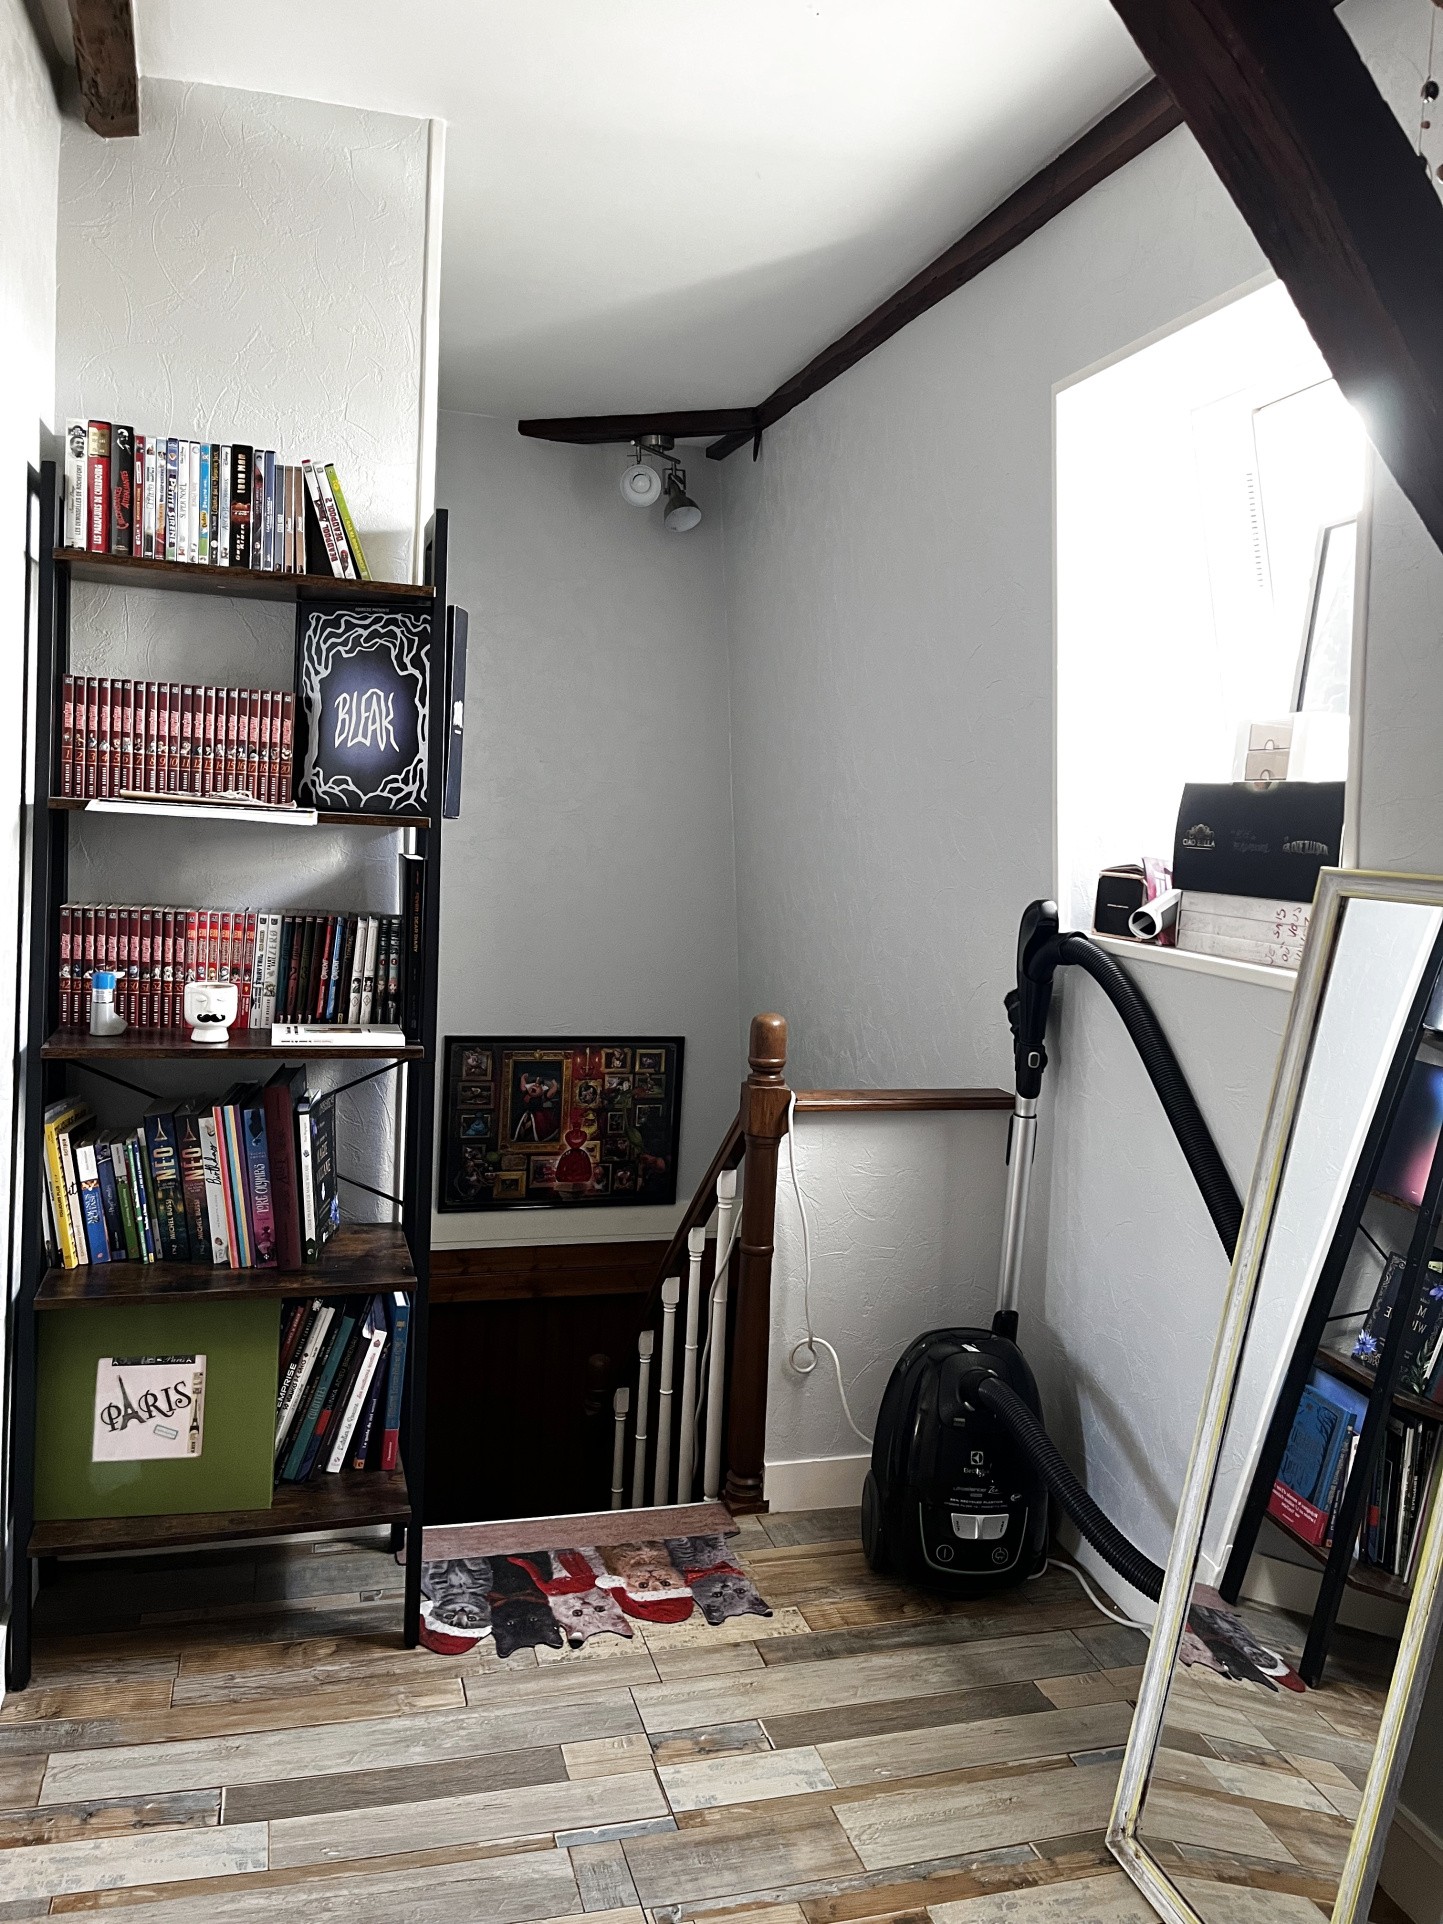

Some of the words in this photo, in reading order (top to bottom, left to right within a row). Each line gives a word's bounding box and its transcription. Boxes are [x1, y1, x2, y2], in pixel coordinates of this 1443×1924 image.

[94, 463, 103, 495] CHERBOURG
[120, 470, 130, 509] ATTENUANTES
[168, 477, 177, 508] PETITE
[94, 504, 103, 534] PARAPLUIES
[179, 499, 187, 519] SUPER
[326, 504, 344, 542] DEADPOOL
[93, 535, 102, 545] LES
[322, 523, 338, 563] DEADPOOL
[334, 688, 400, 753] BLEAK
[76, 750, 83, 758] 2
[88, 751, 96, 760] 3
[135, 755, 142, 764] 7
[159, 756, 166, 765] 9
[1269, 906, 1287, 939] SAIS
[1286, 905, 1304, 938] VOUS
[257, 953, 265, 968] TAIL
[255, 967, 264, 985] FAIRY
[204, 1141, 222, 1186] Birthday
[84, 1193, 93, 1225] MAGNUS
[89, 1192, 98, 1218] CHASE
[165, 1199, 174, 1216] BUSSI
[194, 1199, 202, 1217] BUSSI
[254, 1195, 270, 1213] LORE
[168, 1216, 176, 1240] MICHEL
[195, 1216, 205, 1240] MICHEL
[332, 1368, 348, 1388] ADIEU
[100, 1374, 192, 1433] PARIS
